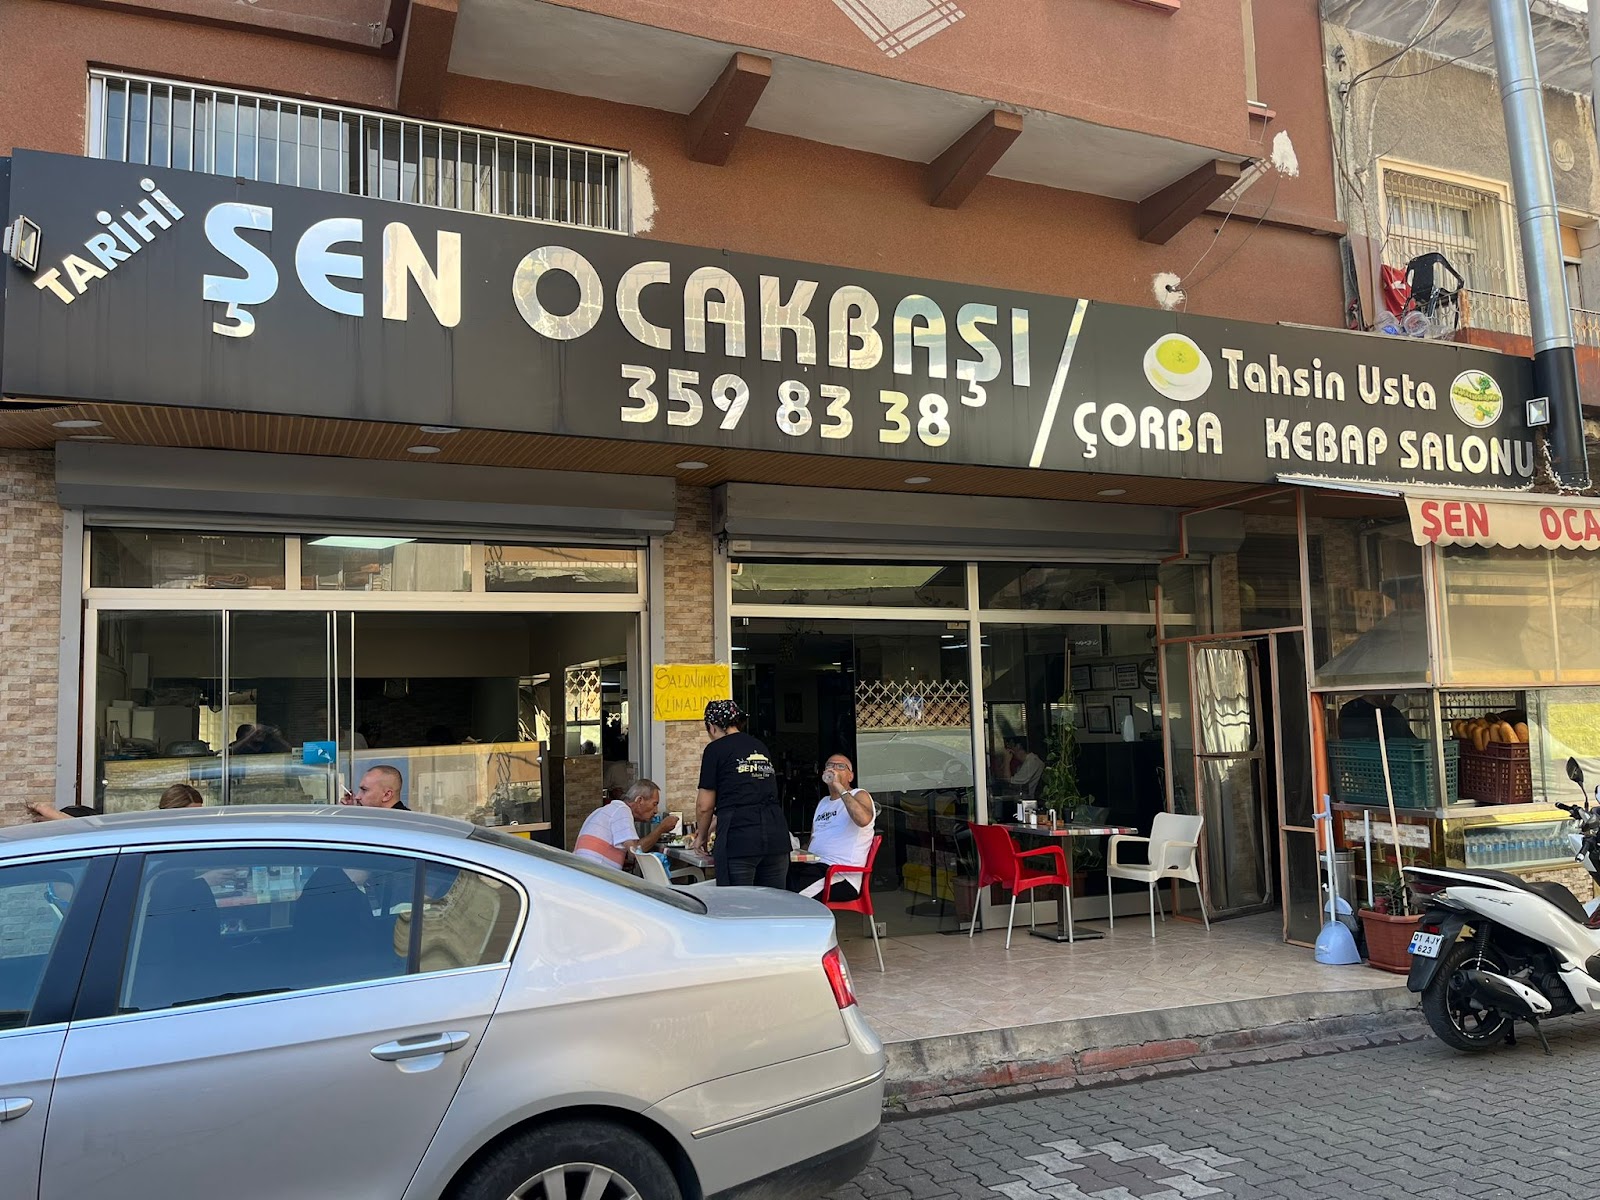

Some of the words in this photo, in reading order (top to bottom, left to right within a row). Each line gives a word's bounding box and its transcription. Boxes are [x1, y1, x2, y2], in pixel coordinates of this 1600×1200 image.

[34, 178, 185, 305] TARİHİ
[203, 202, 462, 338] ŞEN
[512, 245, 1031, 408] OCAKBAŞI
[620, 364, 750, 430] 359
[775, 379, 854, 440] 83
[879, 390, 951, 447] 38
[1221, 348, 1345, 402] Tahsin
[1357, 364, 1437, 411] Usta
[1073, 402, 1223, 459] ÇORBA
[1265, 417, 1388, 466] KEBAP
[1399, 431, 1535, 478] SALONU
[1421, 501, 1489, 542] ŞEN
[1413, 933, 1423, 942] 01
[1425, 935, 1441, 945] AJY
[1417, 945, 1433, 955] 623
